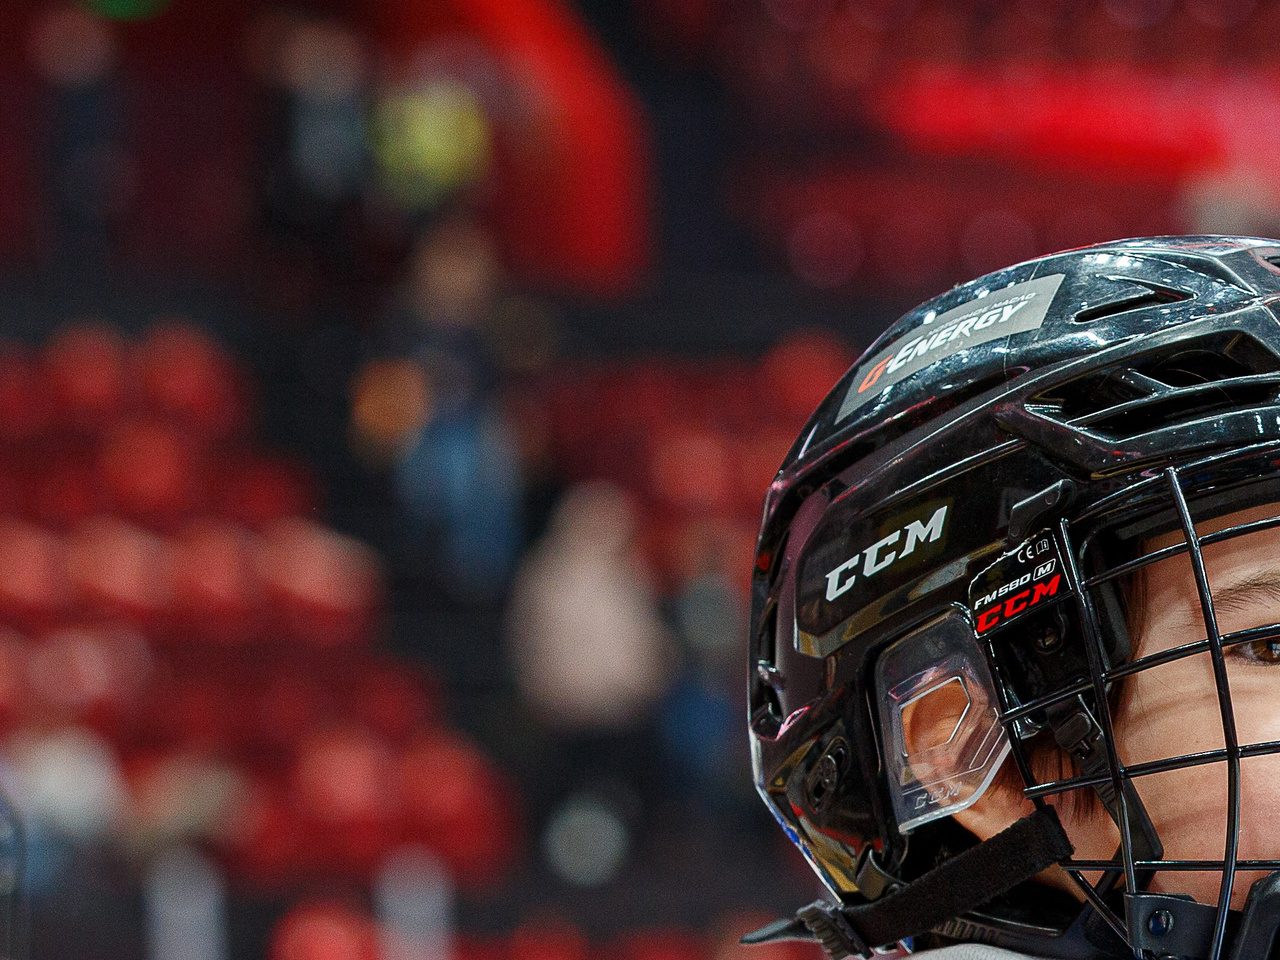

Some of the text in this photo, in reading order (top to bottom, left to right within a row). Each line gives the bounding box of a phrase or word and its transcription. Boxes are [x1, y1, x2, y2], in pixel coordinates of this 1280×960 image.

[825, 505, 948, 602] CCM
[974, 572, 1032, 611] FM580
[976, 573, 1061, 634] CCM
